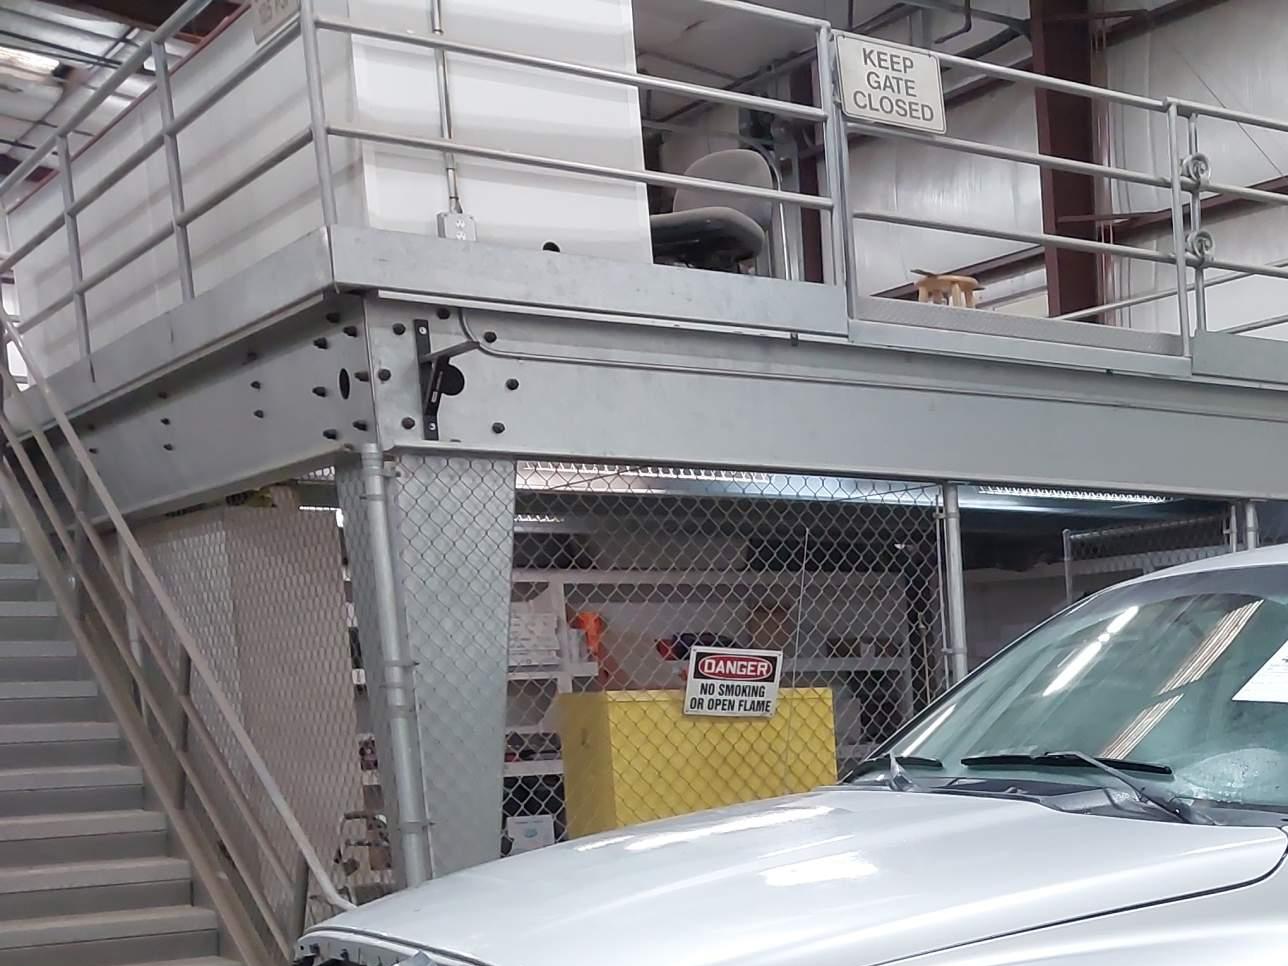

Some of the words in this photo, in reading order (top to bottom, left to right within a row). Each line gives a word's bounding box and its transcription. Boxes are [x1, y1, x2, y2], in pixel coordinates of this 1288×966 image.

[862, 47, 914, 74] KEEP
[866, 71, 917, 98] GATE
[853, 90, 934, 121] CLOSED
[703, 659, 769, 676] DANGER
[700, 683, 715, 696] NO
[718, 683, 766, 698] SMOKING
[690, 697, 704, 710] OR
[707, 698, 735, 712] OPEN
[738, 700, 772, 713] FLAME
